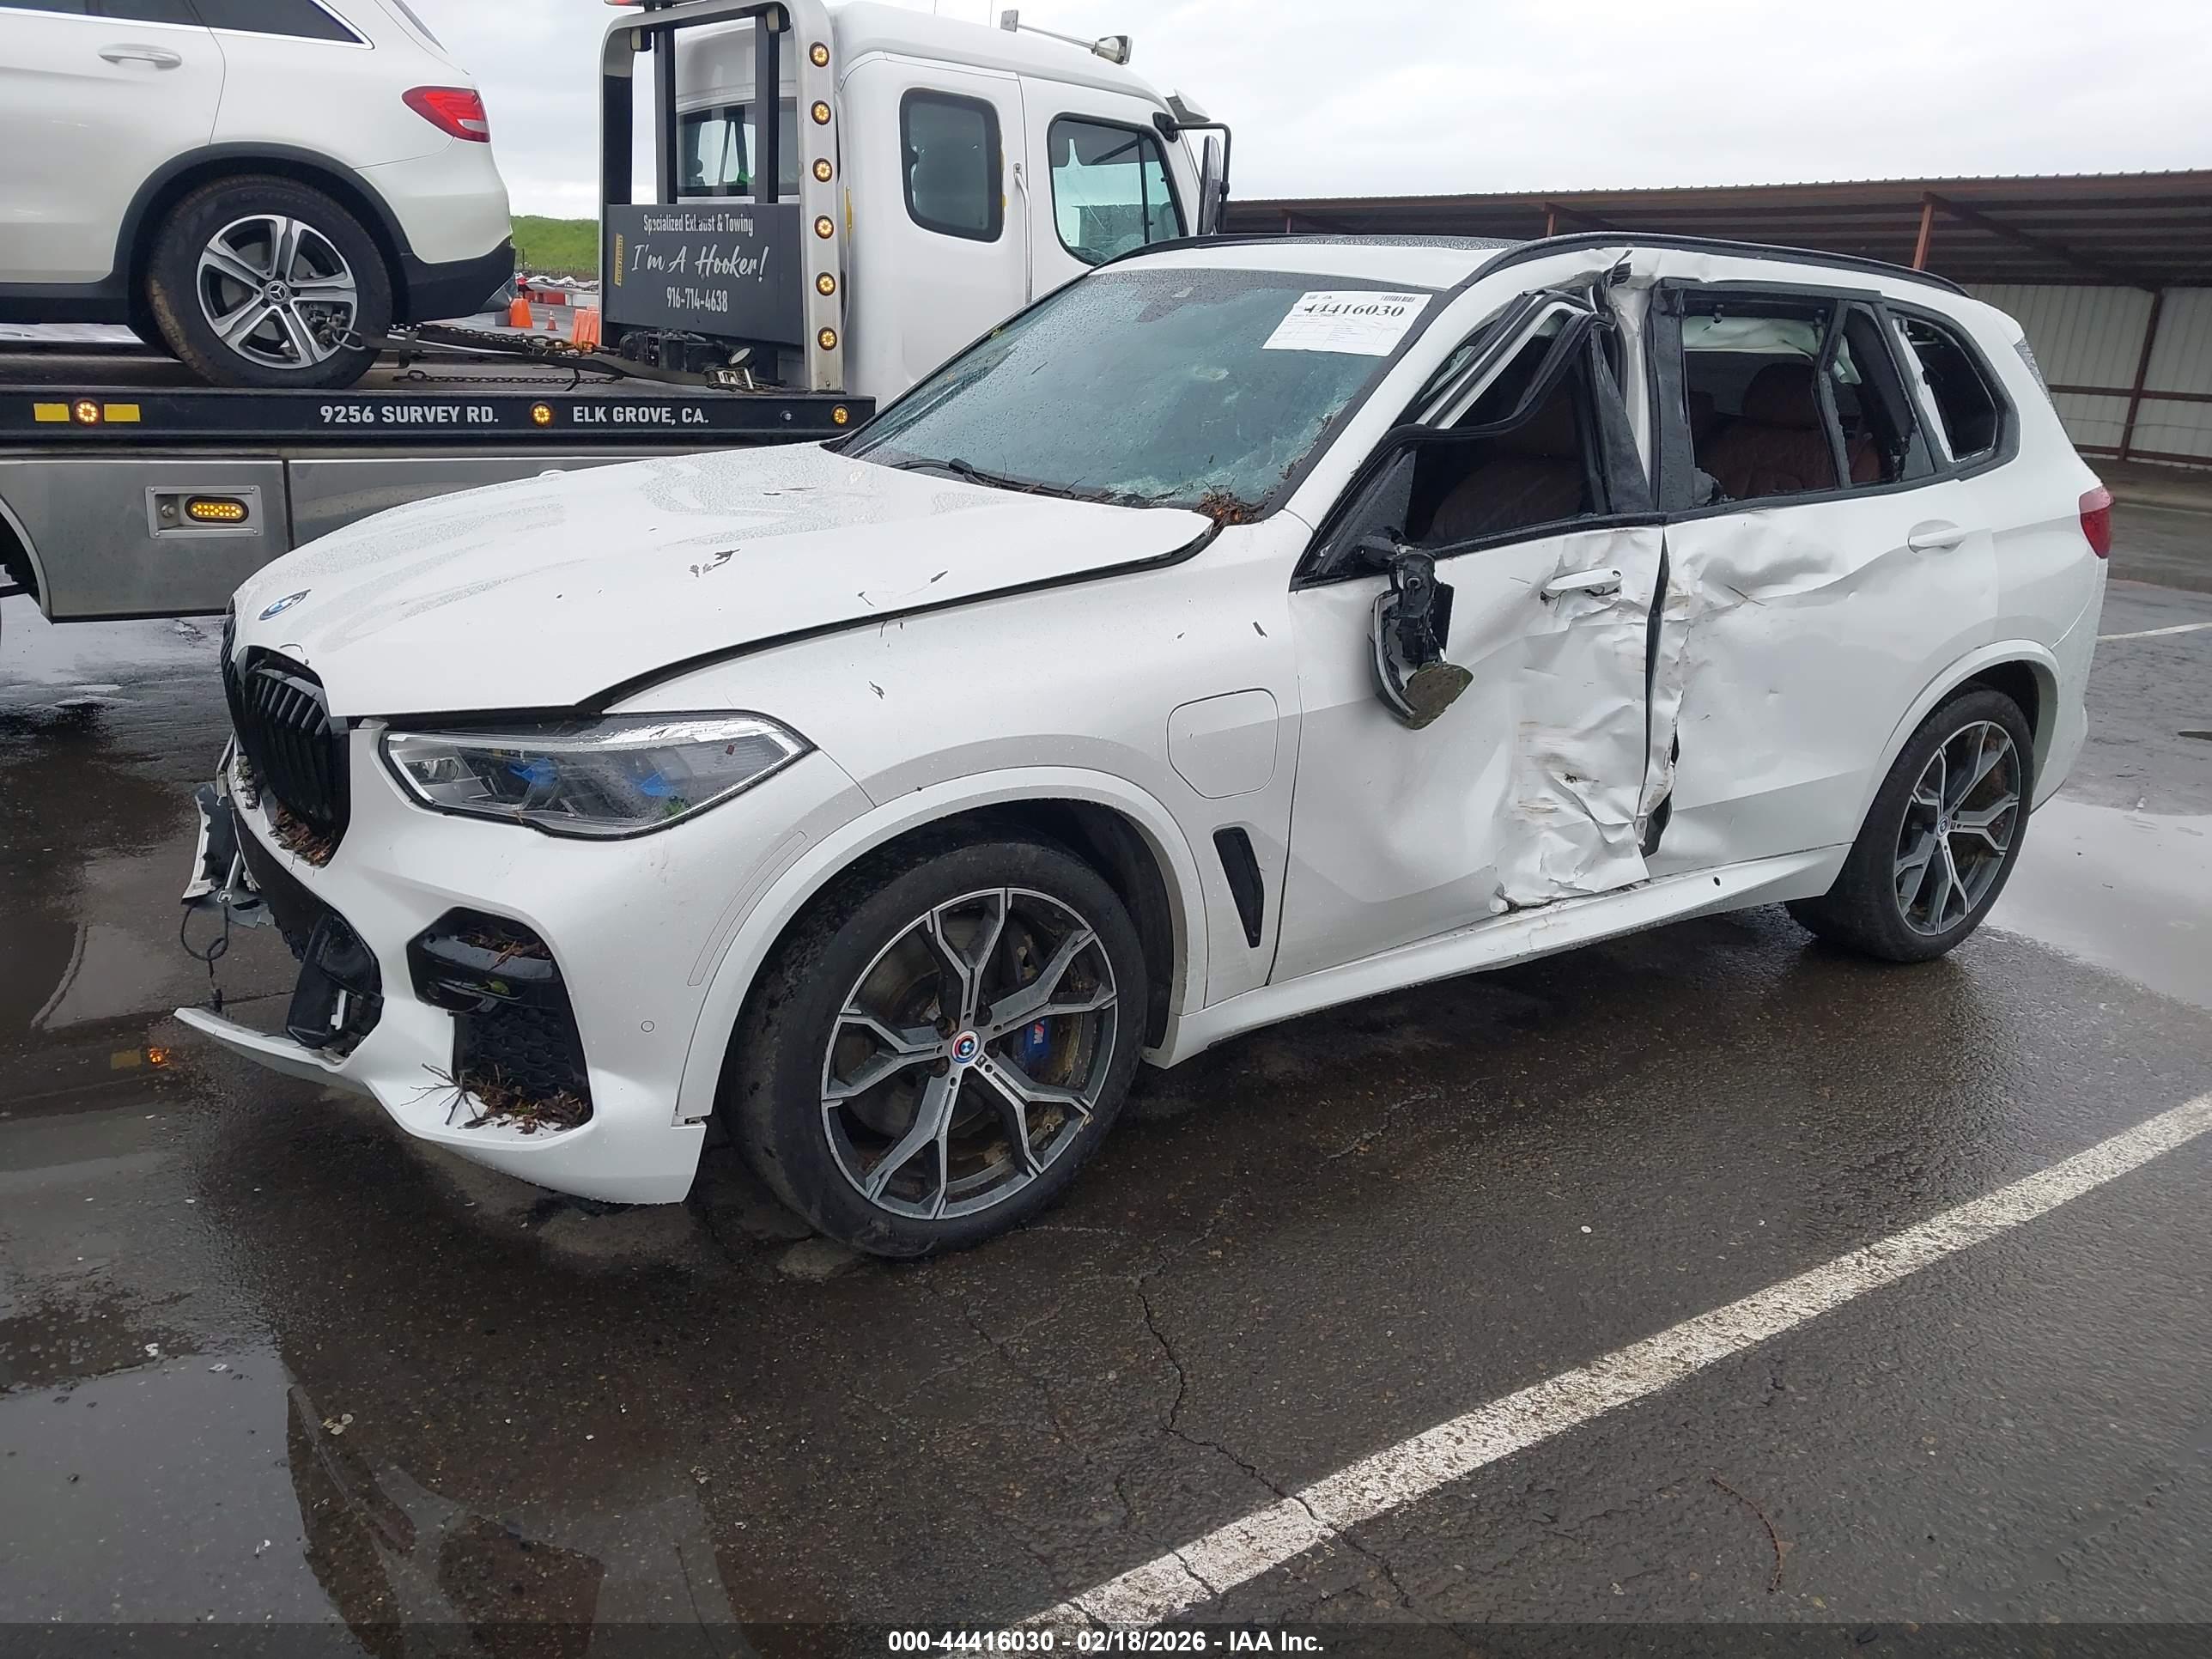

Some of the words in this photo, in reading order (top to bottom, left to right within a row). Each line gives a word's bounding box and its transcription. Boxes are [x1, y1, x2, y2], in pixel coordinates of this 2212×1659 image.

[643, 213, 684, 236] Specialized
[716, 213, 723, 233] &
[725, 213, 754, 238] Towing
[631, 243, 665, 272] I'm
[666, 245, 688, 274] A
[694, 243, 769, 283] Hooker!
[666, 286, 728, 313] 916-714-4638
[1304, 303, 1405, 318] 44416030
[319, 405, 375, 424] 9256
[381, 405, 463, 424] SURVEY
[466, 405, 500, 424] RD.
[572, 406, 608, 424] ELK
[611, 406, 677, 426] GROVE,
[681, 406, 710, 424] CA.
